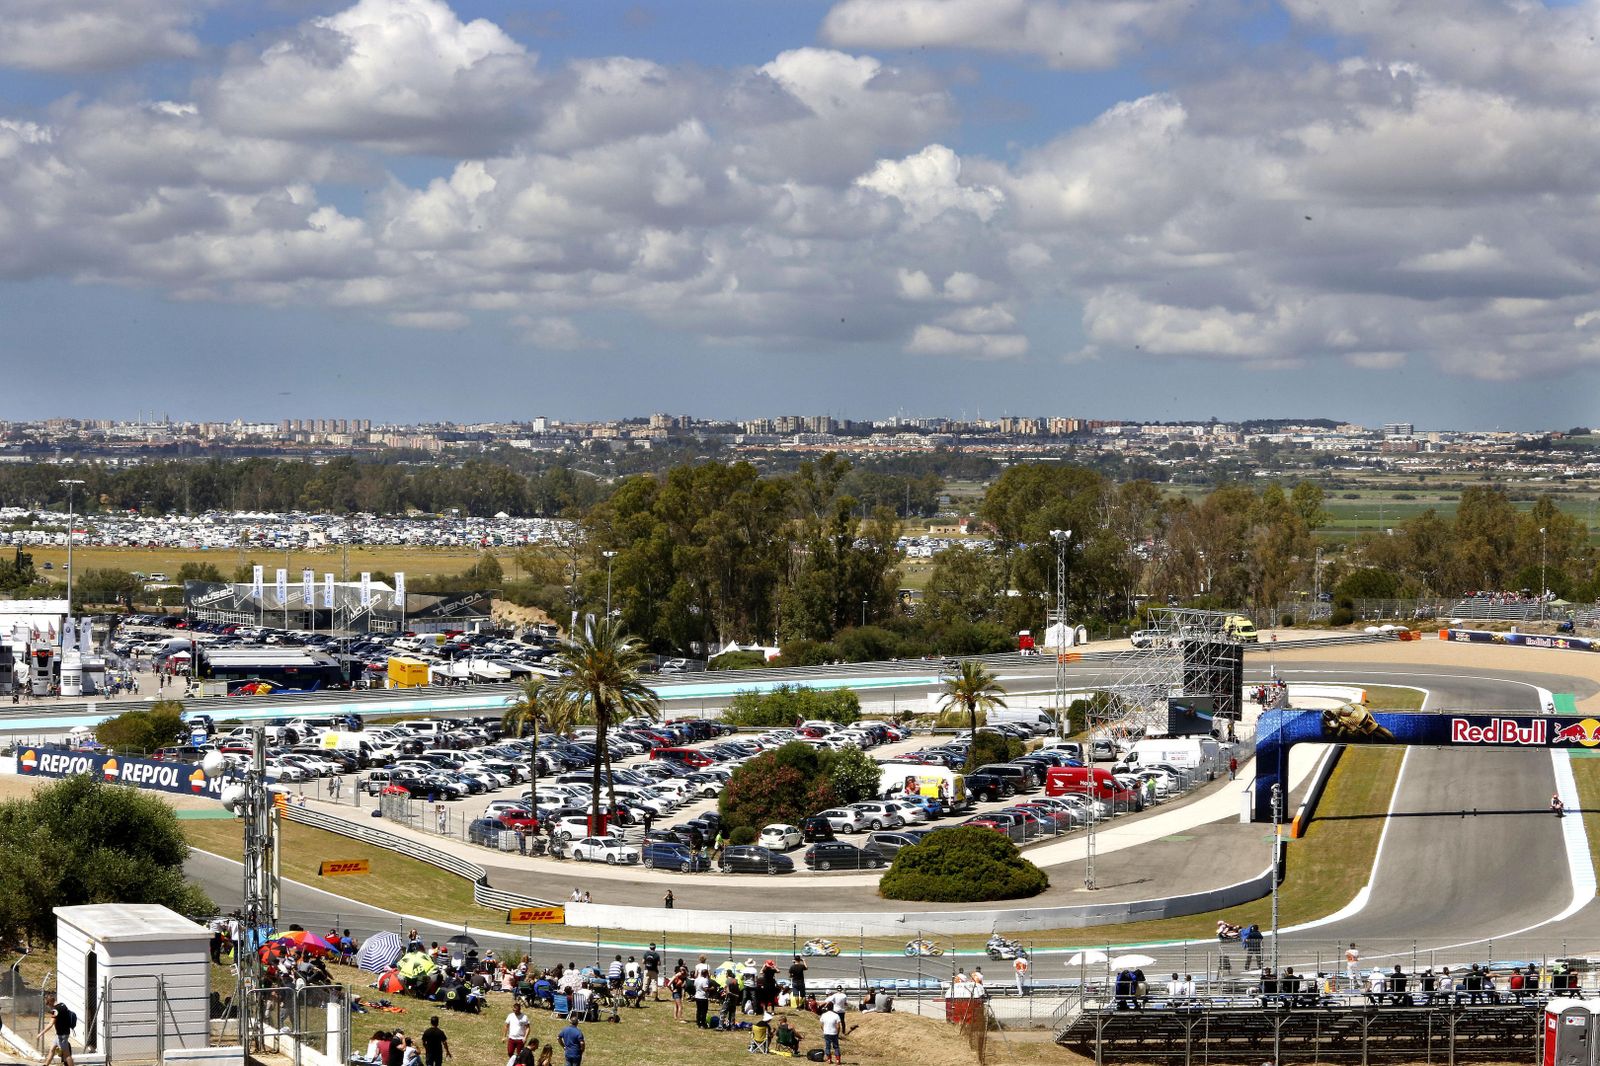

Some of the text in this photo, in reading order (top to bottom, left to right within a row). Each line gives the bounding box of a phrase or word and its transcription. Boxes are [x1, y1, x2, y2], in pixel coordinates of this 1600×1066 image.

[198, 587, 235, 604] MUSEO
[432, 592, 482, 616] TIENDA
[1451, 718, 1547, 744] Red Bull
[39, 753, 93, 775] REPSOL
[121, 762, 179, 788] REPSOL
[330, 862, 361, 873] DHL
[519, 911, 555, 921] DHL
